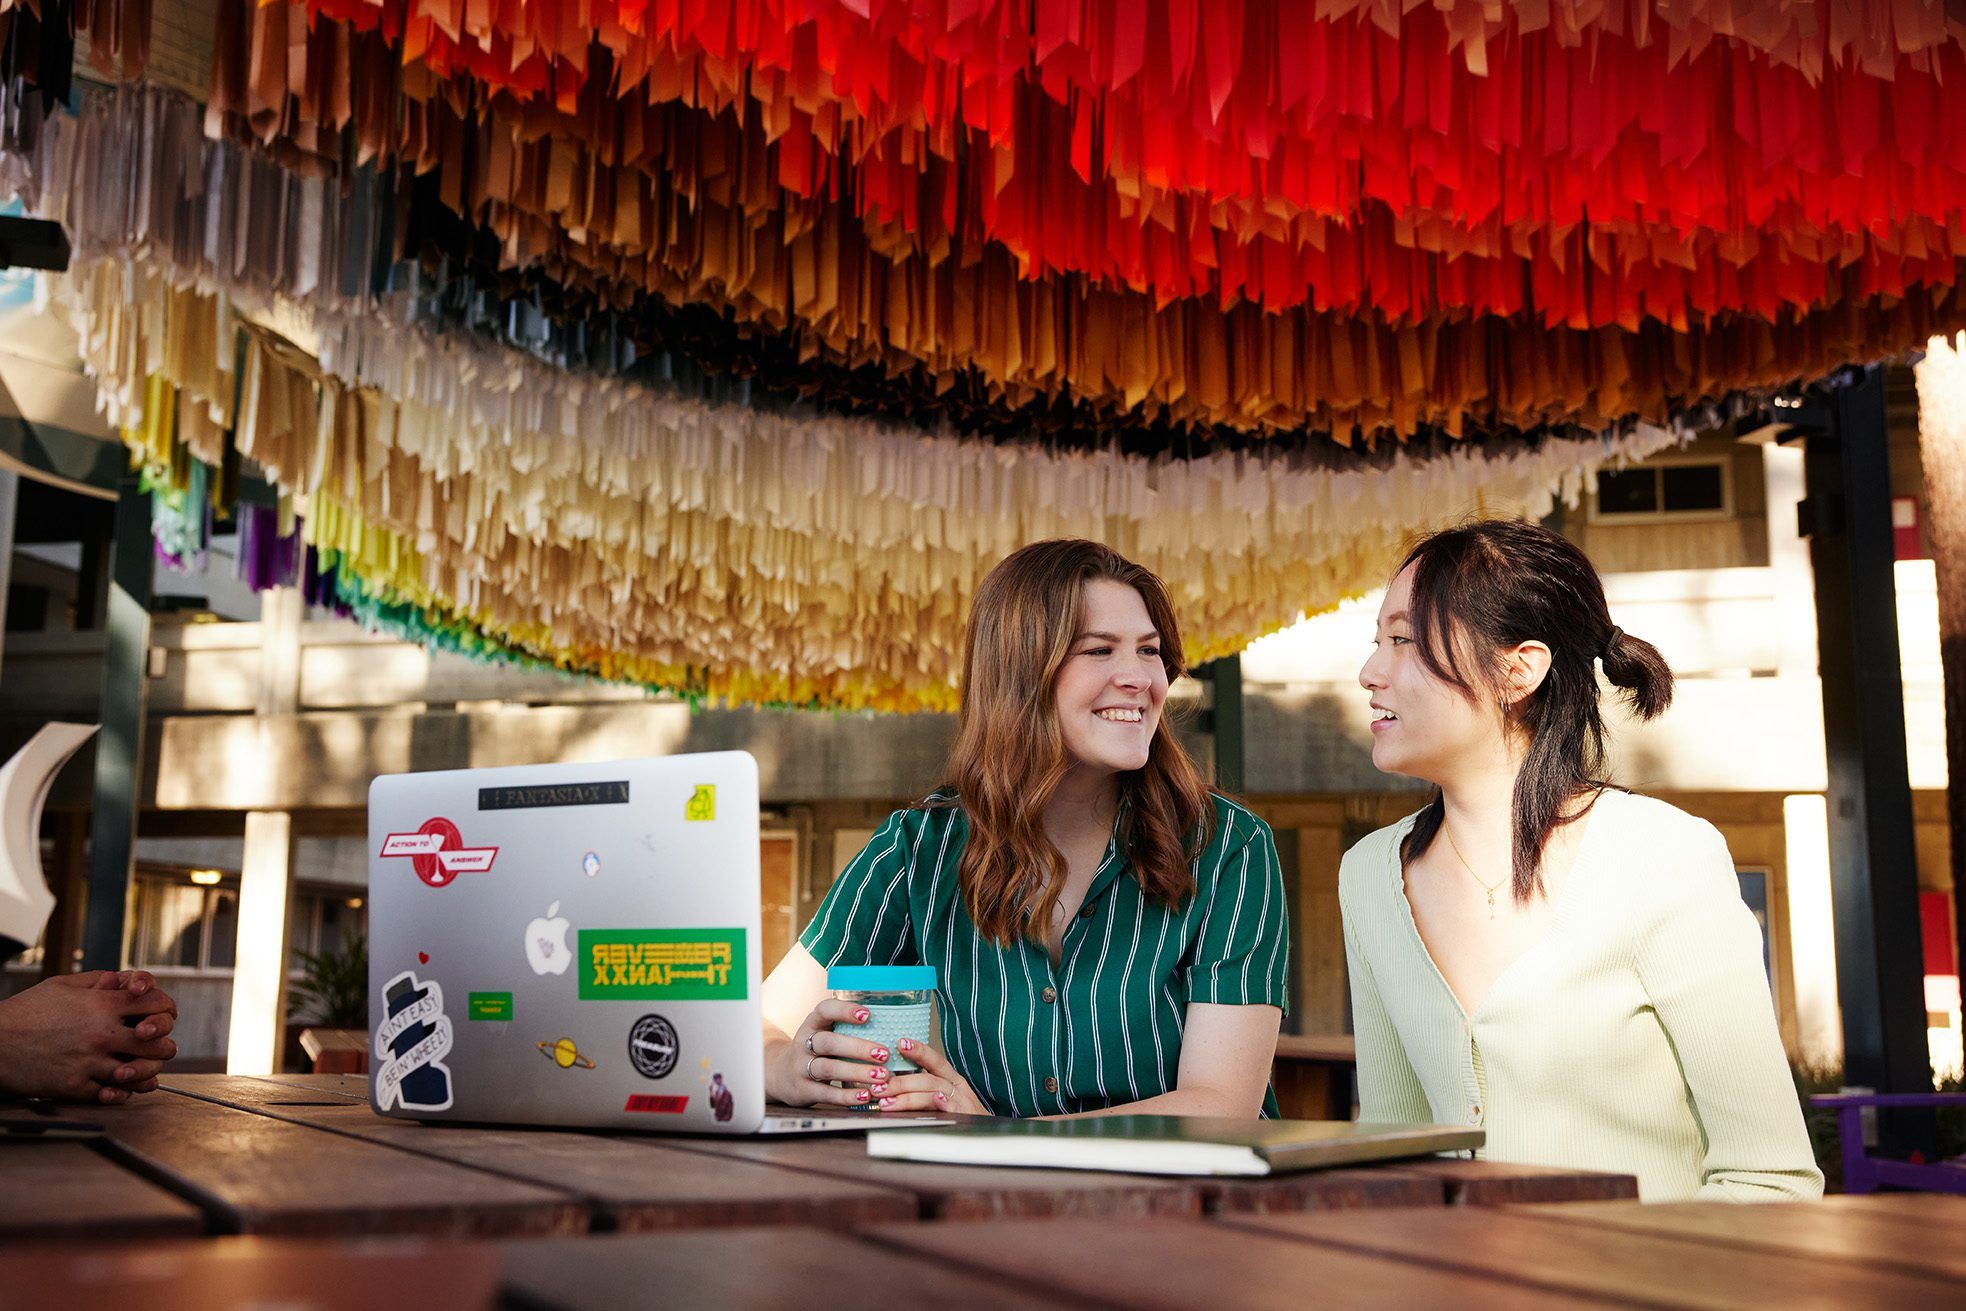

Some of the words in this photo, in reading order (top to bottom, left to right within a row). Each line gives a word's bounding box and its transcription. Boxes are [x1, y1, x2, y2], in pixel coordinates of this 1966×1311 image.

[390, 840, 417, 848] ACTION
[410, 994, 437, 1021] EASY
[412, 1027, 447, 1064] WHEEZY
